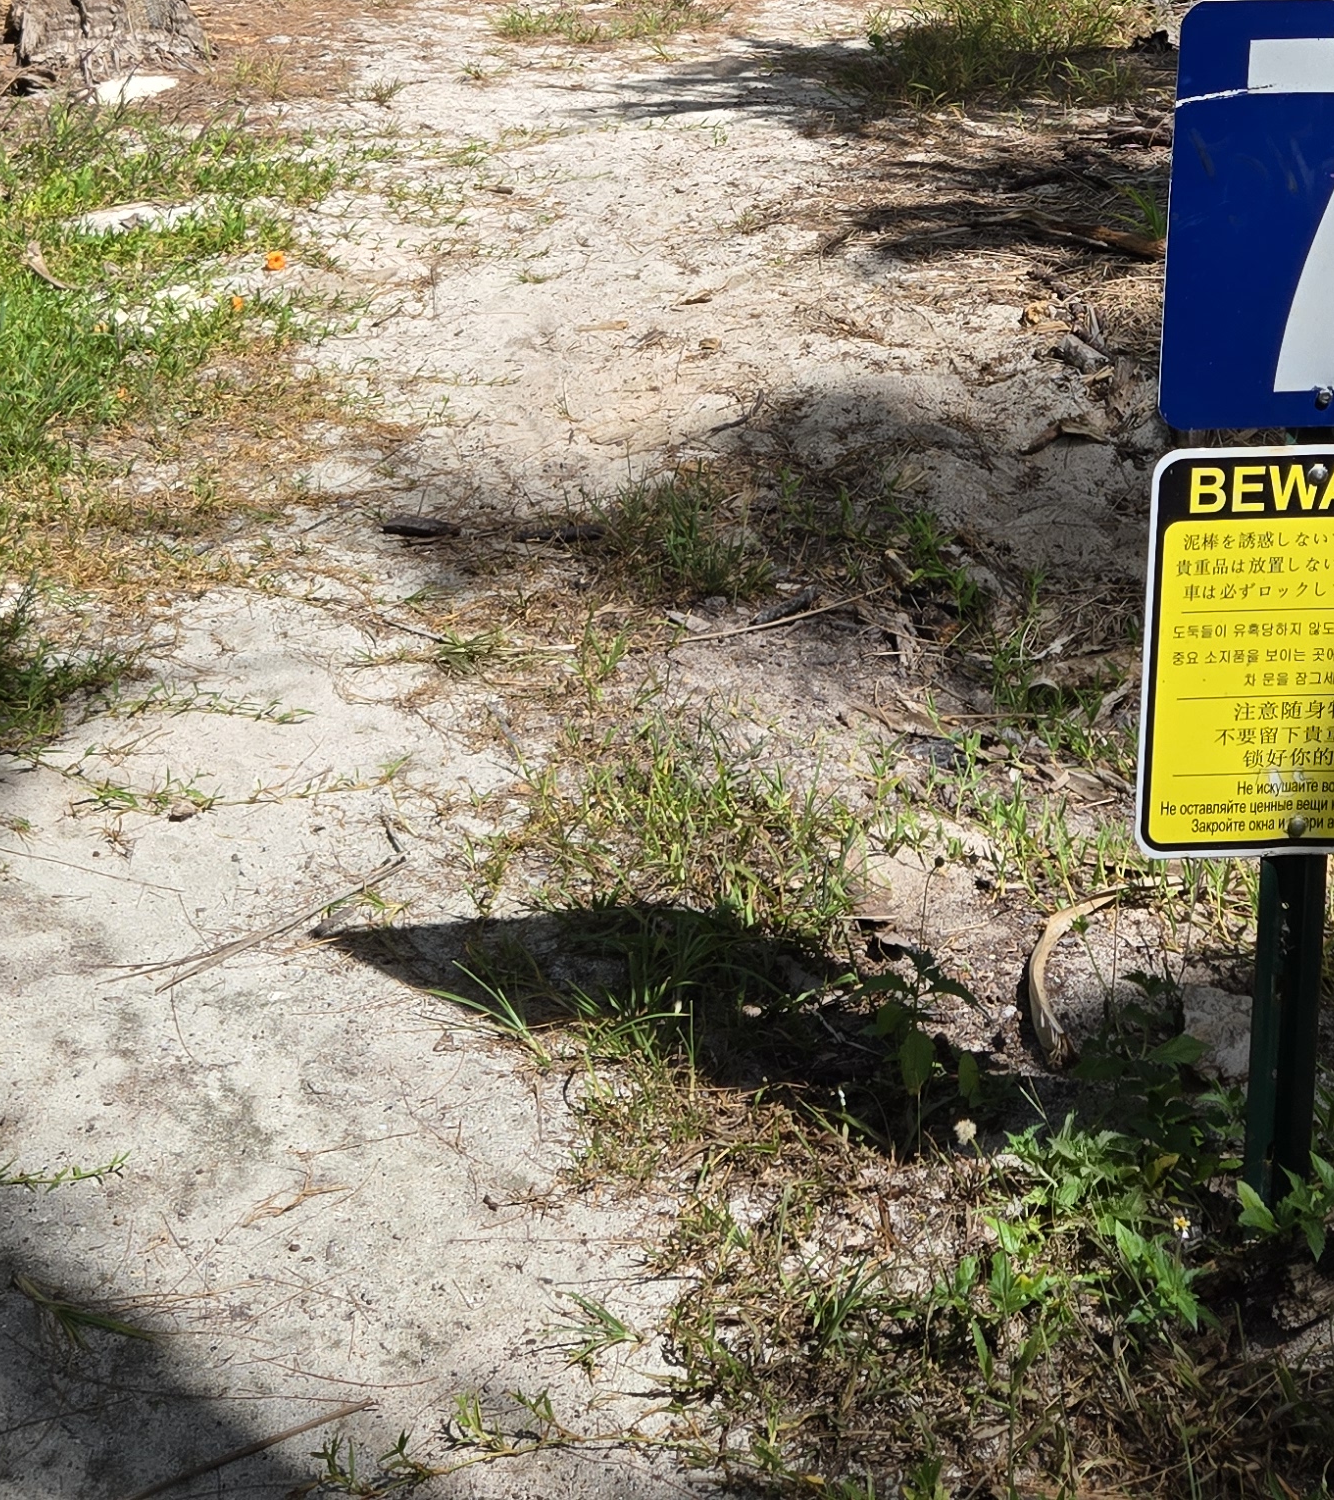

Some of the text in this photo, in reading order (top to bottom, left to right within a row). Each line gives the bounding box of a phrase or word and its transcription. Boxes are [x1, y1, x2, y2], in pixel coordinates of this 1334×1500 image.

[1173, 624, 1227, 639] 도둑들이
[1233, 622, 1302, 637] 유혹당하지
[1172, 651, 1199, 666] 중요
[1205, 649, 1259, 664] 소지품을
[1265, 648, 1306, 662] 보이는
[1244, 673, 1256, 687] 차
[1263, 672, 1289, 686] 문을
[1237, 781, 1253, 795] Не
[1160, 801, 1176, 816] Не
[1180, 800, 1246, 815] оставляйте
[1249, 800, 1293, 815] ценные
[1296, 800, 1328, 813] вещи
[1191, 818, 1245, 835] Закройте
[1249, 819, 1275, 831] окна
[1278, 819, 1285, 829] и
